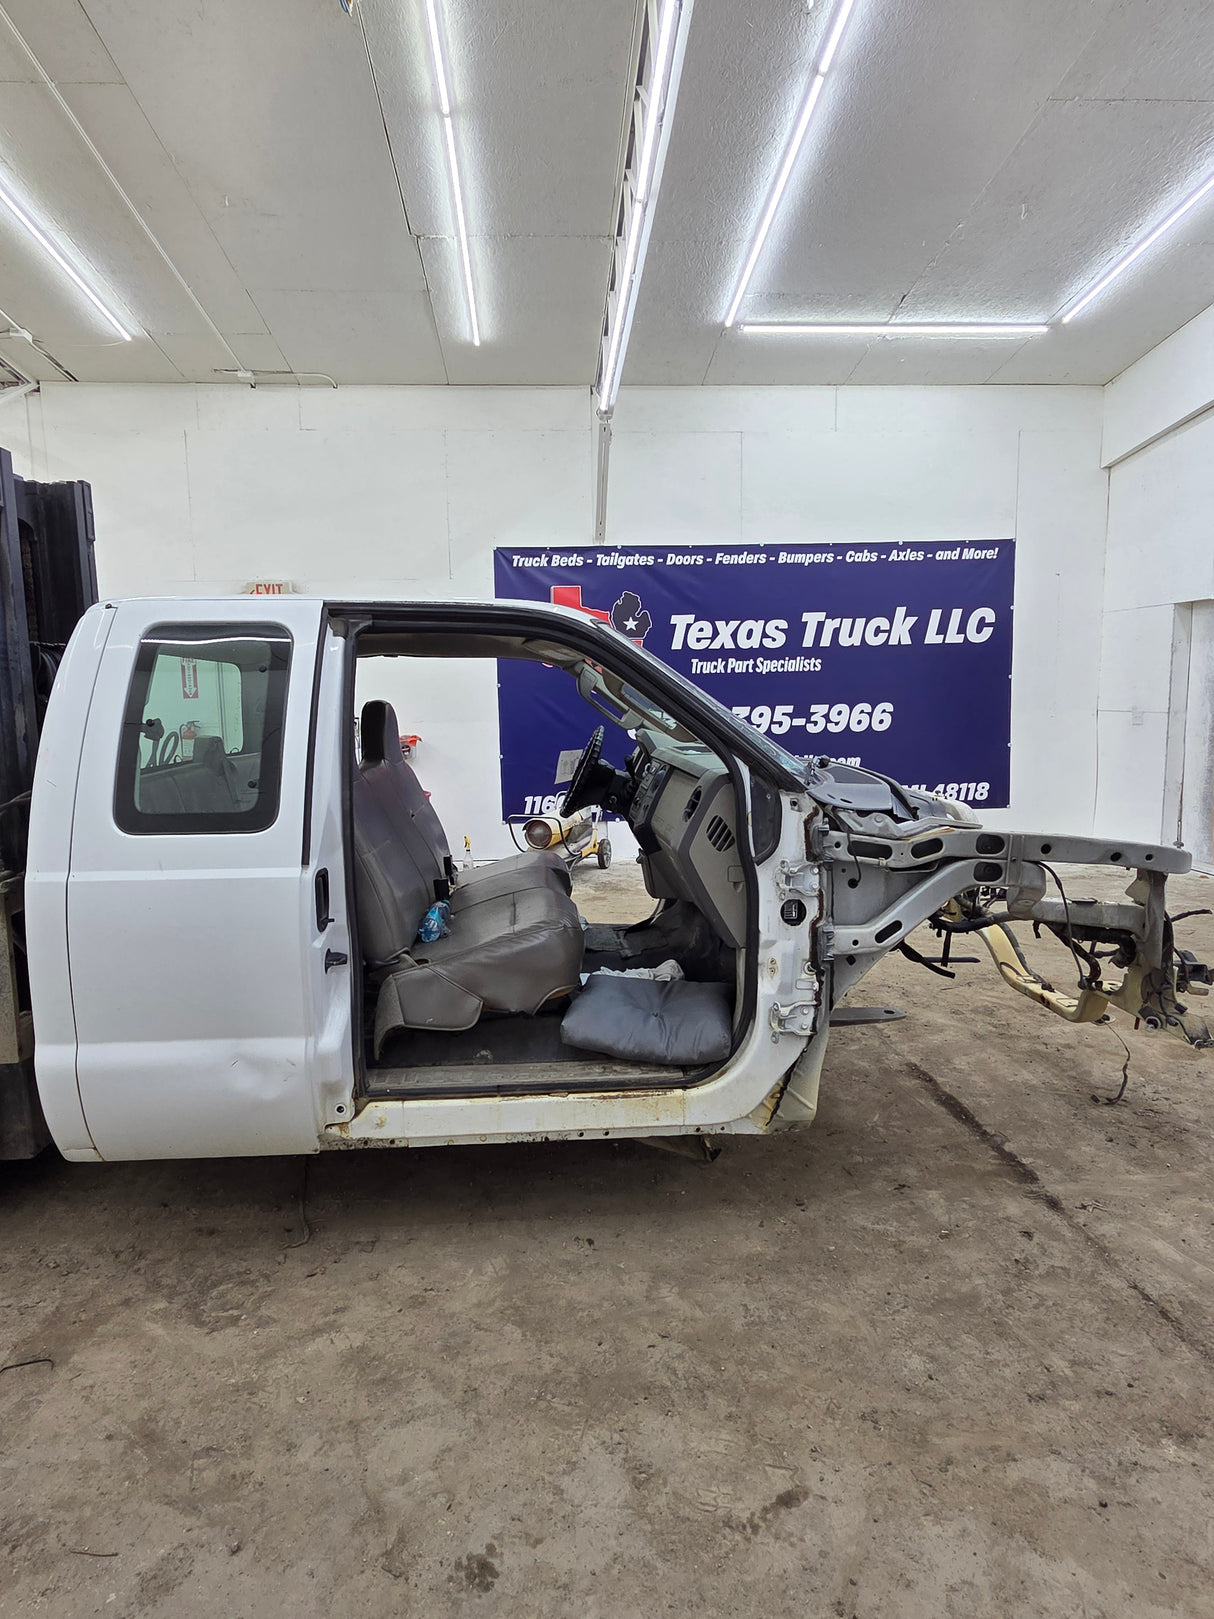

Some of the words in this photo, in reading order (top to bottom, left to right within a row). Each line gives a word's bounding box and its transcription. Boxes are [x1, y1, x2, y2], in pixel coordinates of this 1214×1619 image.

[512, 554, 549, 567] Truck
[550, 553, 584, 566] Beds
[596, 552, 655, 569] Tailgates
[666, 553, 704, 565] Doors
[715, 551, 767, 565] Fenders
[778, 551, 834, 566] Bumpers
[845, 549, 878, 562] Cabs
[888, 548, 924, 561] Axles
[935, 548, 960, 561] and
[961, 547, 999, 560] More!
[669, 614, 788, 650] Texas
[801, 606, 918, 648] Truck
[924, 607, 996, 644] LLC
[691, 658, 726, 674] Truck
[727, 657, 754, 673] Part
[756, 655, 822, 675] Specialists
